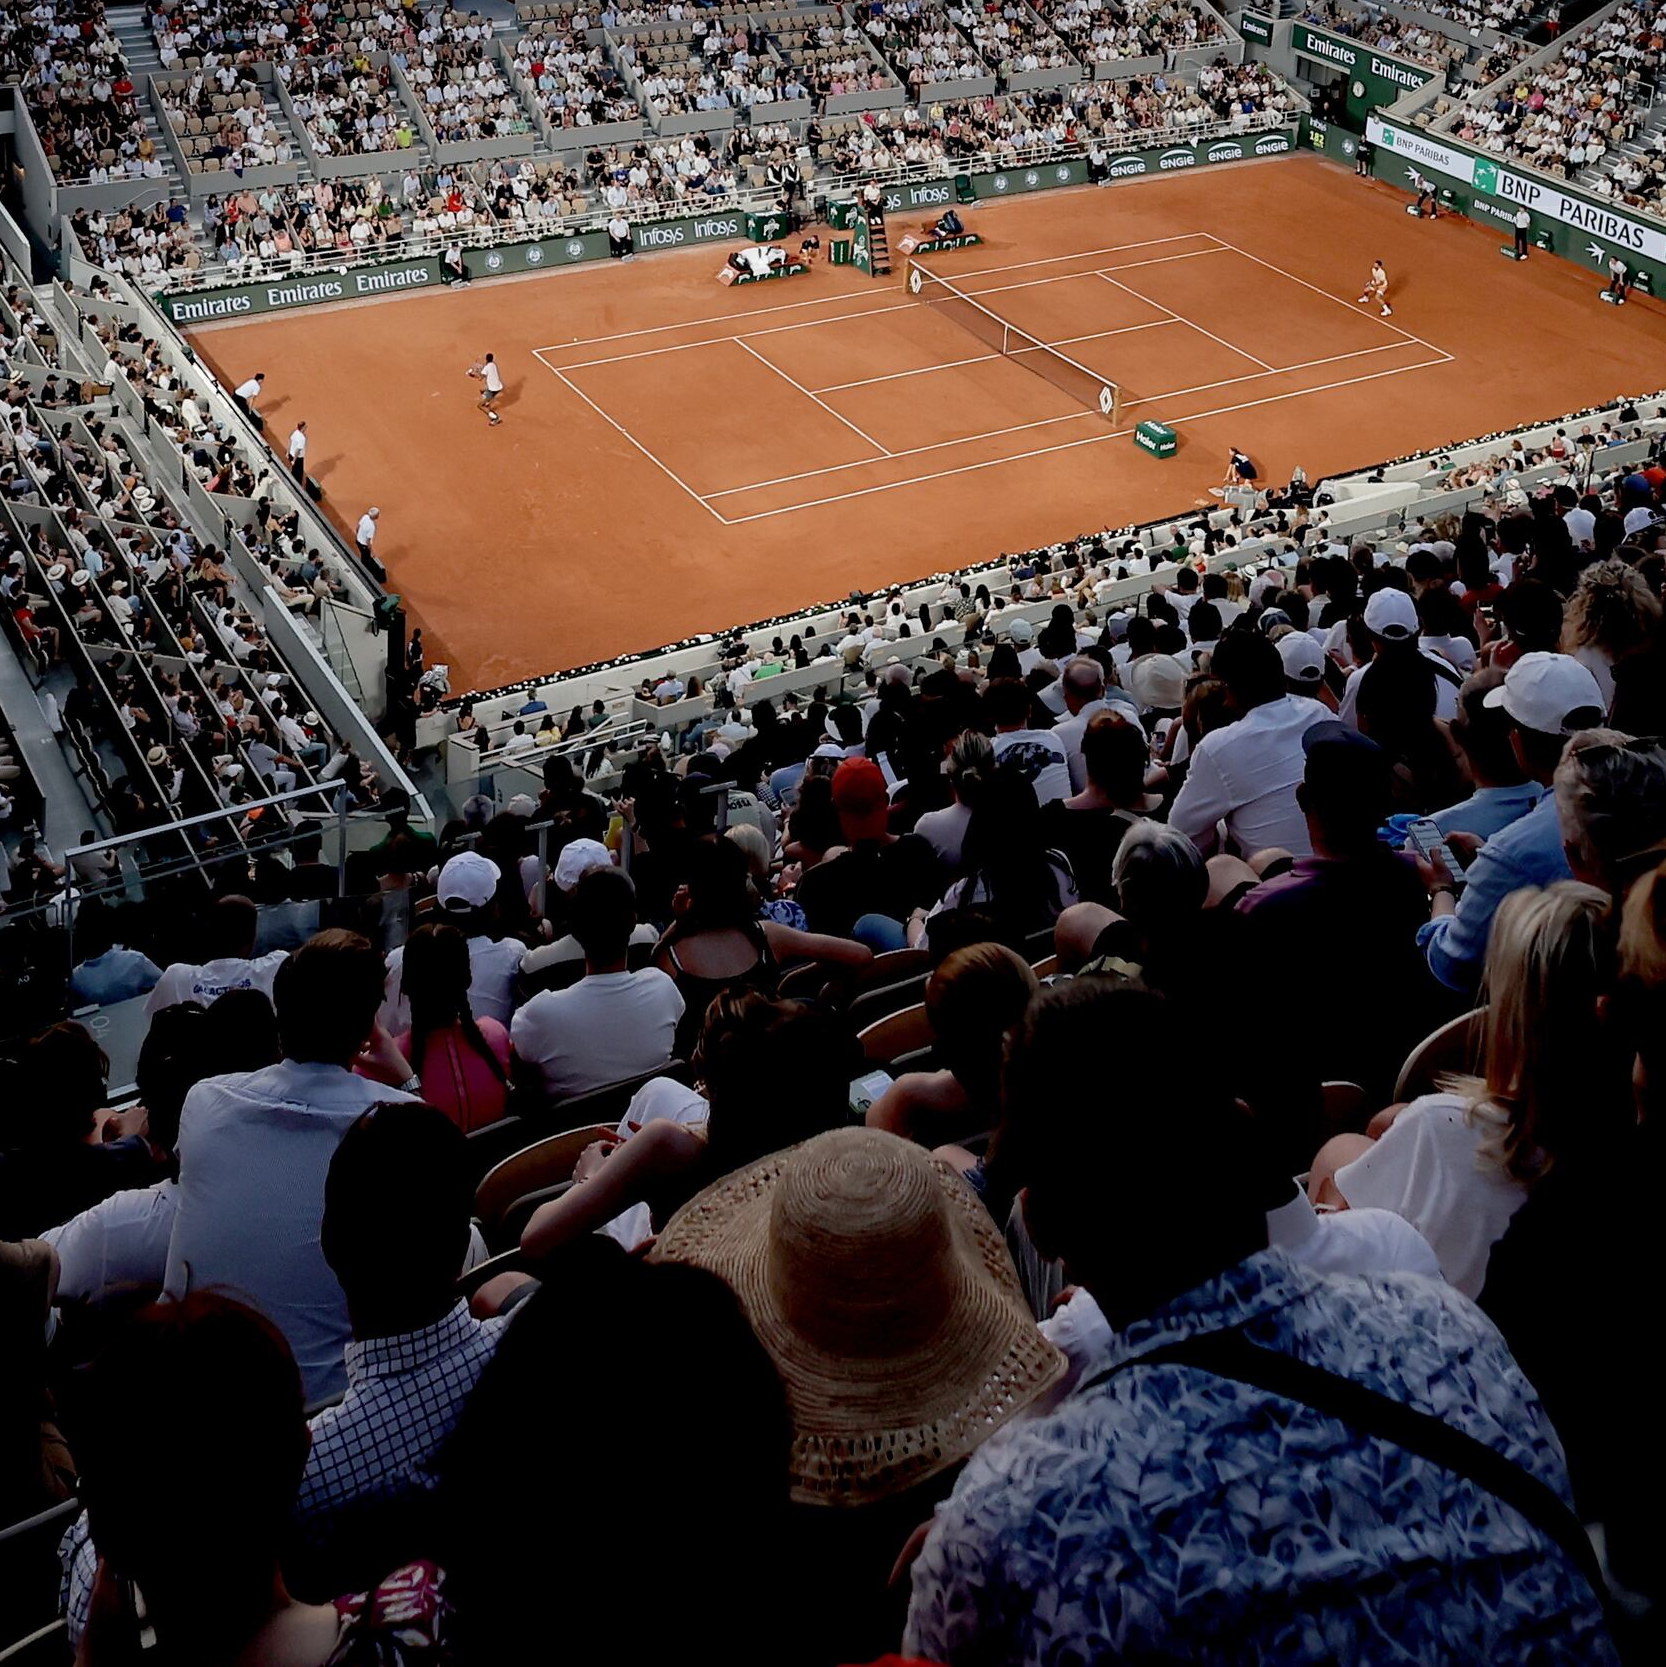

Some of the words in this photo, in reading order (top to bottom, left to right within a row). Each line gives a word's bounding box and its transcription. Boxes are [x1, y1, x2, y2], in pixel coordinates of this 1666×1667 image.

[1243, 20, 1268, 37] Emirates
[1306, 33, 1357, 66] Emirates
[1371, 57, 1424, 89] Emirates
[1396, 136, 1414, 151] BNP
[1414, 143, 1450, 166] PARIBAS
[910, 185, 950, 206] Infosys
[1473, 199, 1491, 213] BNP
[1490, 206, 1517, 224] PARIBA
[1502, 175, 1541, 204] BNP
[1559, 198, 1645, 248] PARIBAS
[640, 226, 684, 247] Infosys
[694, 218, 737, 238] Infosys
[356, 266, 428, 292] Emirates
[267, 281, 342, 306] Emirates
[172, 295, 250, 320] Emirates
[1136, 430, 1156, 450] Haier
[193, 979, 252, 995] GALACTOS
